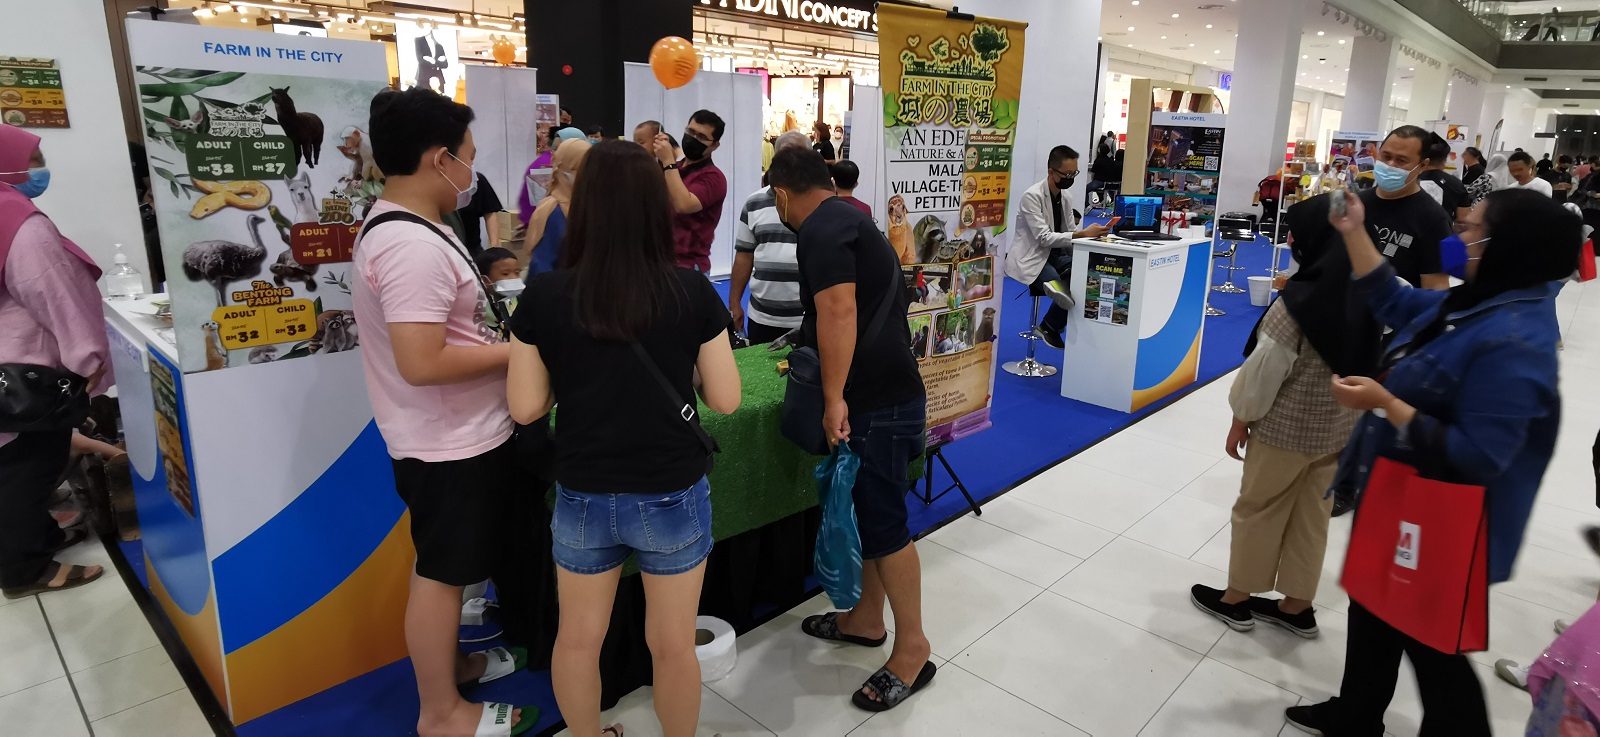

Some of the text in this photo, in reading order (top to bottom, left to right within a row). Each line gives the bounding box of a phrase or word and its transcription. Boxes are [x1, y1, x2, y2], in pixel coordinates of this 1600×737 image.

[800, 0, 871, 29] CONCEPT
[204, 42, 342, 63] FARM IN THE CITY
[902, 79, 994, 95] FARM IN THE CITY
[901, 129, 964, 146] AN EDE
[196, 141, 231, 149] ADULT
[900, 149, 943, 159] NATURE
[946, 150, 955, 159] &
[211, 164, 234, 176] 32
[265, 163, 285, 174] 27
[929, 164, 963, 176] MALA
[915, 196, 960, 209] PETTIN
[318, 212, 354, 222] ZOO
[299, 228, 329, 236] ADULT
[316, 248, 332, 257] 21
[1150, 254, 1180, 267] EASTIN HOTEL
[252, 282, 271, 290] The
[233, 288, 292, 301] BENTONG
[248, 297, 280, 306] FARM
[224, 310, 256, 319] ADULT
[277, 305, 306, 313] CHILD
[287, 324, 306, 335] 32
[238, 330, 259, 342] 32
